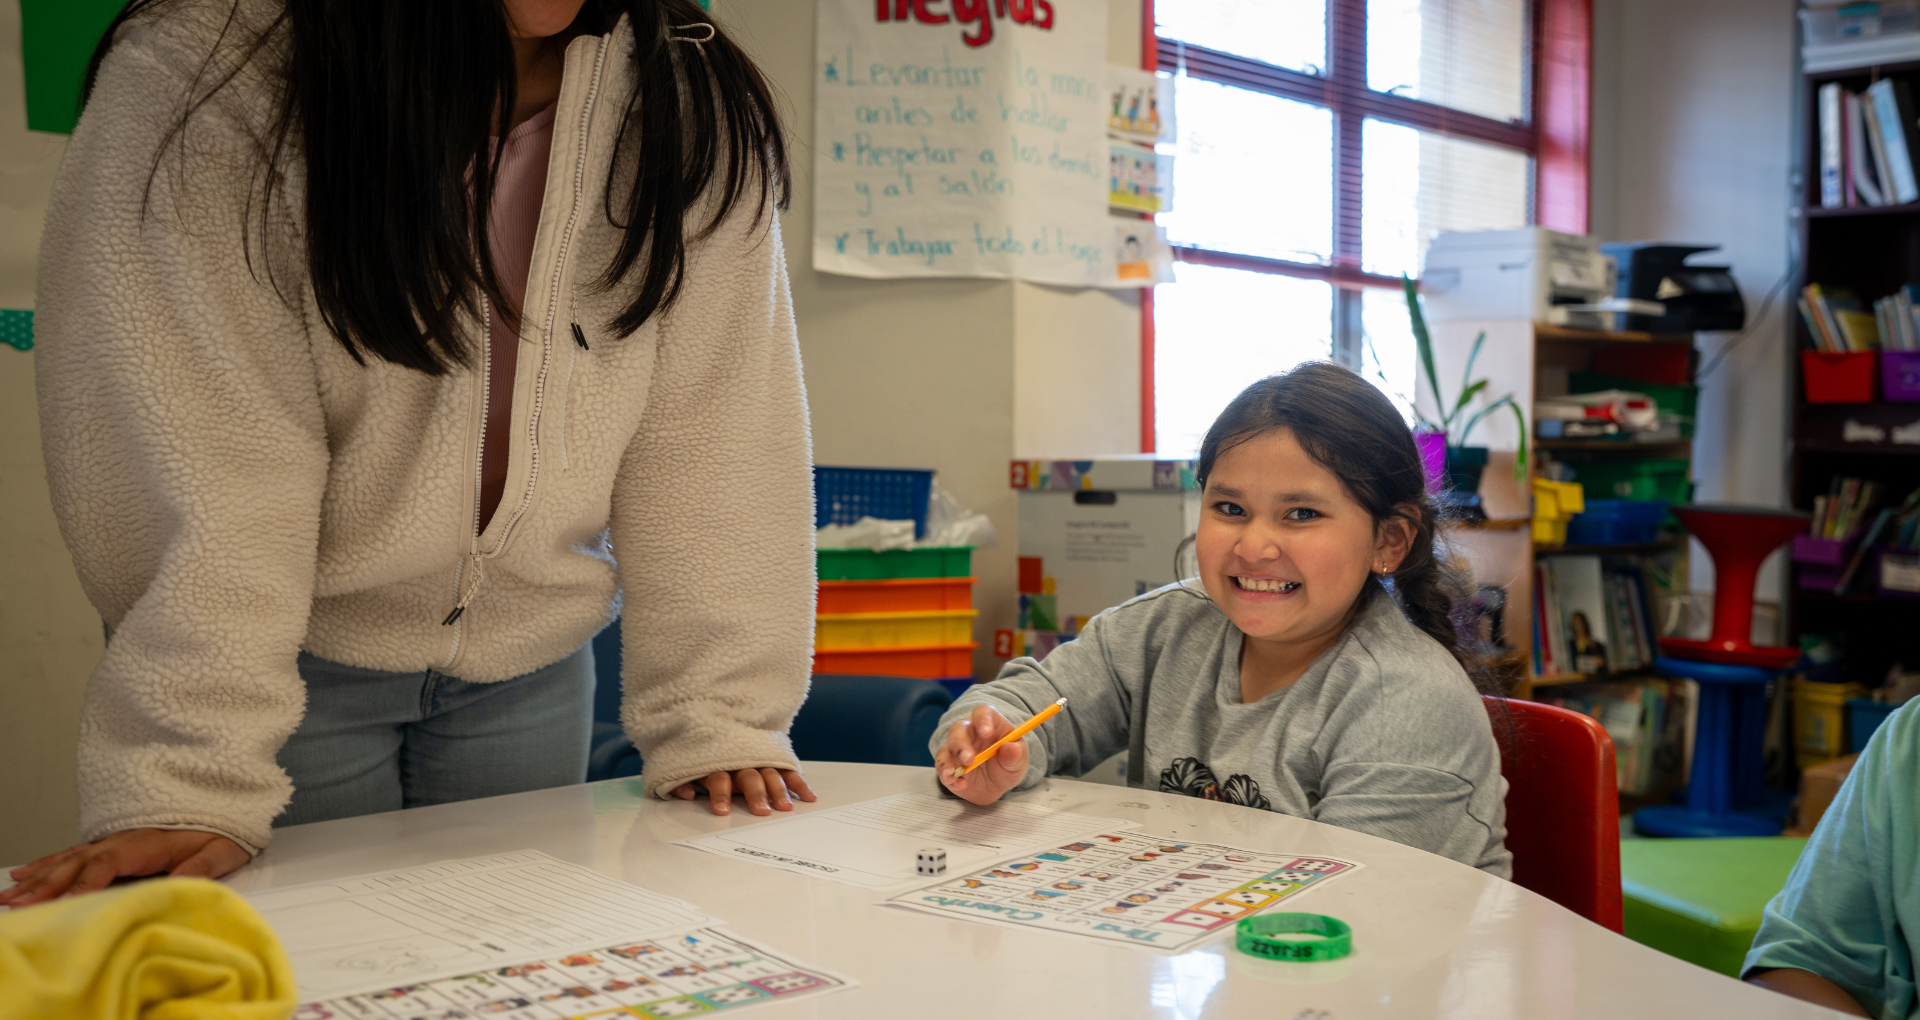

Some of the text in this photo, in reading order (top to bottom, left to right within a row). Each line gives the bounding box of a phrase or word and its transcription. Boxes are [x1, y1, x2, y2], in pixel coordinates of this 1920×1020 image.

[846, 46, 987, 87] Levantar
[1014, 48, 1039, 87] la
[856, 93, 1072, 133] antes de hablar
[854, 132, 964, 177] Respetar
[979, 149, 998, 166] a
[1011, 136, 1043, 166] los
[855, 169, 1015, 218] y al salón
[858, 227, 960, 266] Trabajar
[971, 220, 1025, 256] todo
[1031, 225, 1048, 257] el
[922, 896, 1044, 920] Cuento
[1251, 940, 1314, 958] SFJAZZ
